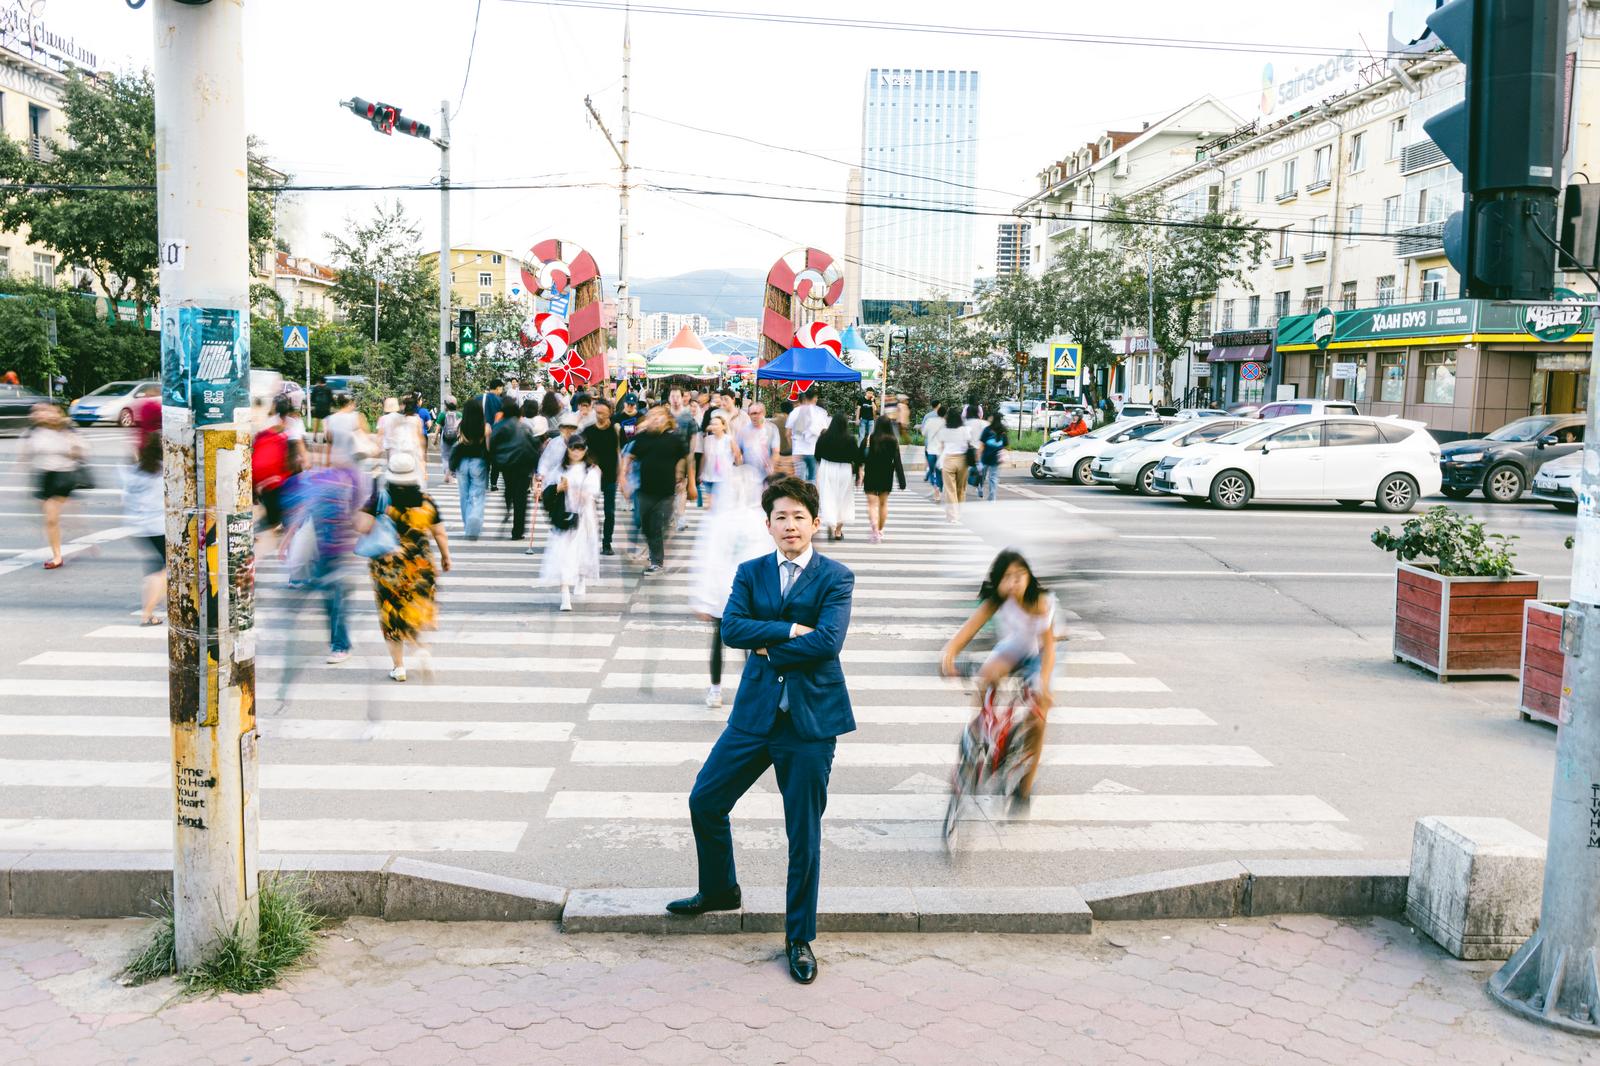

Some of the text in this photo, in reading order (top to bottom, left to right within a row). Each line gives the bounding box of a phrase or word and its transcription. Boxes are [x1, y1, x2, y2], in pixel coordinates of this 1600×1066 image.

[1371, 310, 1426, 332] ХААН БУУЗ
[176, 764, 203, 777] Time
[176, 775, 186, 786] To
[176, 786, 198, 798] Your
[177, 796, 205, 809] Heart
